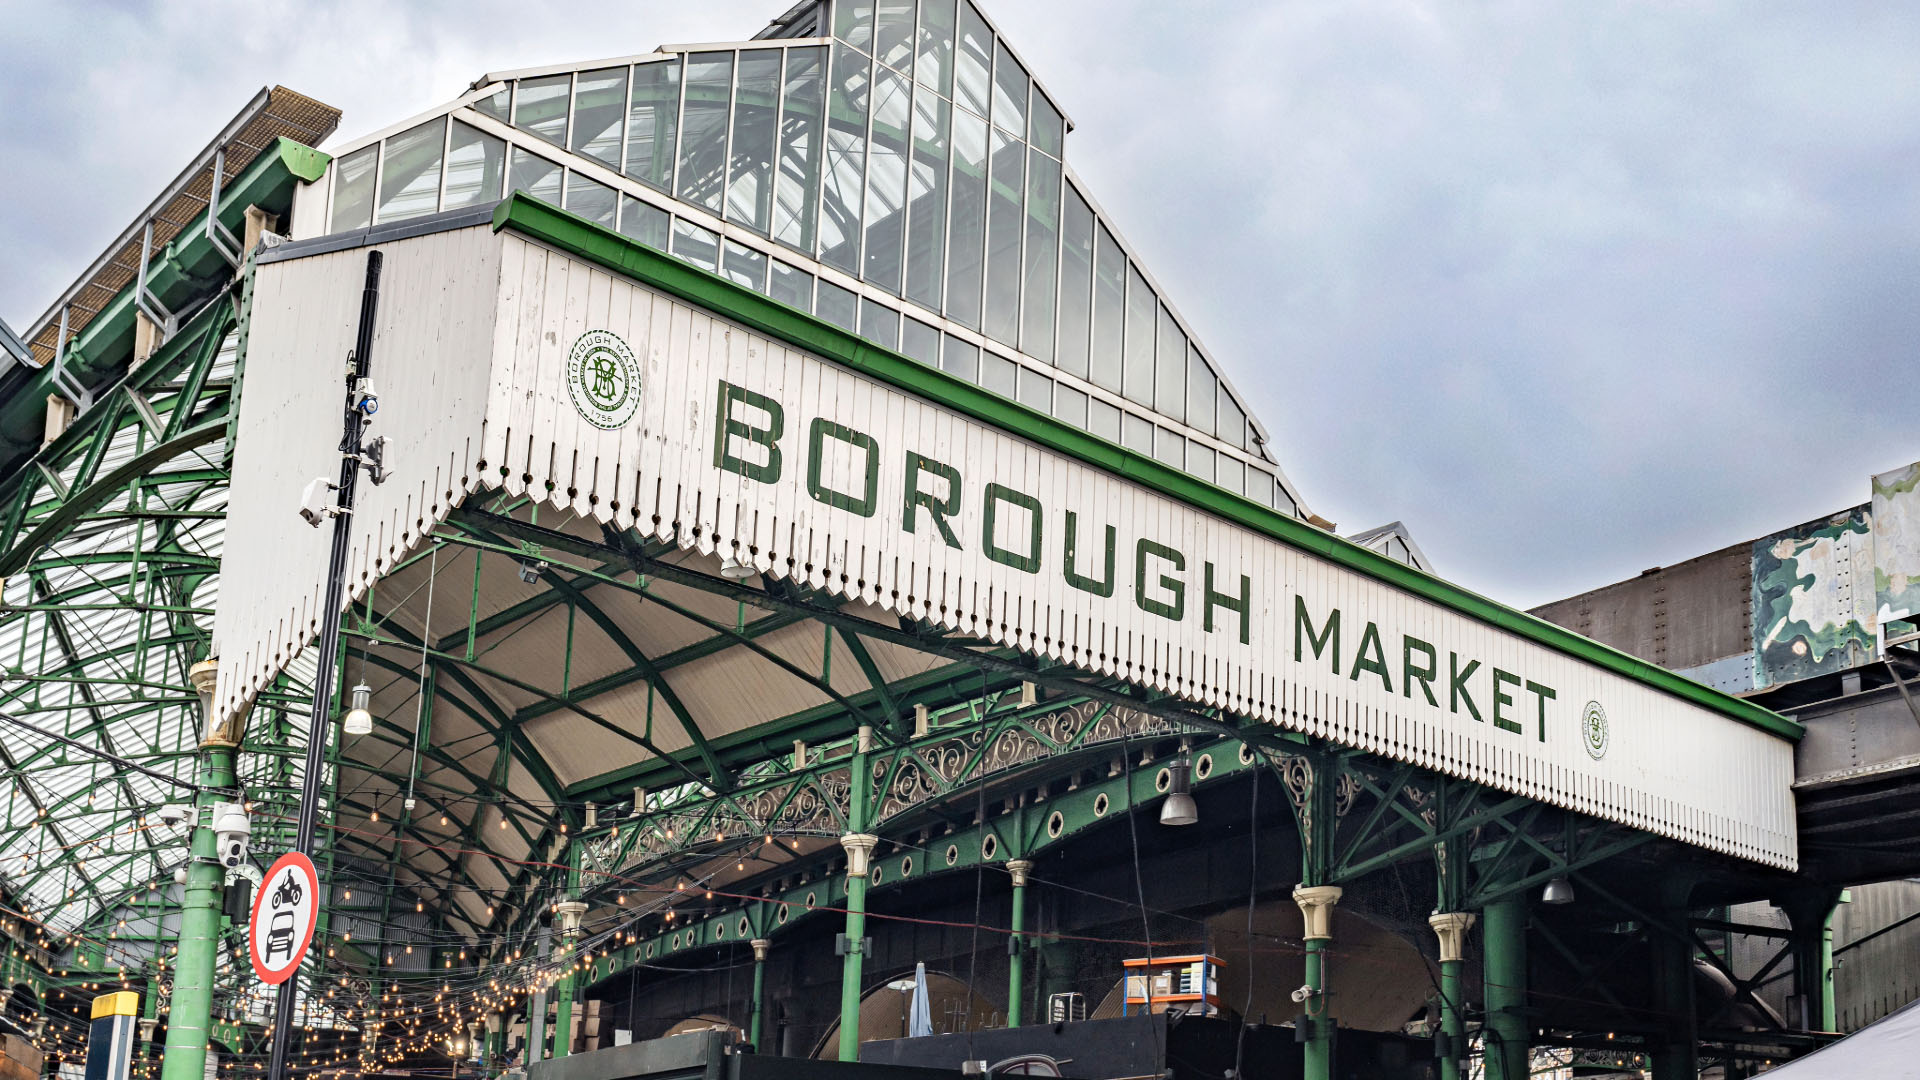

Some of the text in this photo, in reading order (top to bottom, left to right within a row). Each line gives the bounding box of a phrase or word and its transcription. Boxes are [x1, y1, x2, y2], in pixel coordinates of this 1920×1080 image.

[572, 336, 610, 383] BOROUGH
[616, 344, 637, 404] MARKET
[591, 409, 613, 422] 1756
[713, 379, 1557, 743] BOROUGH MARKET
